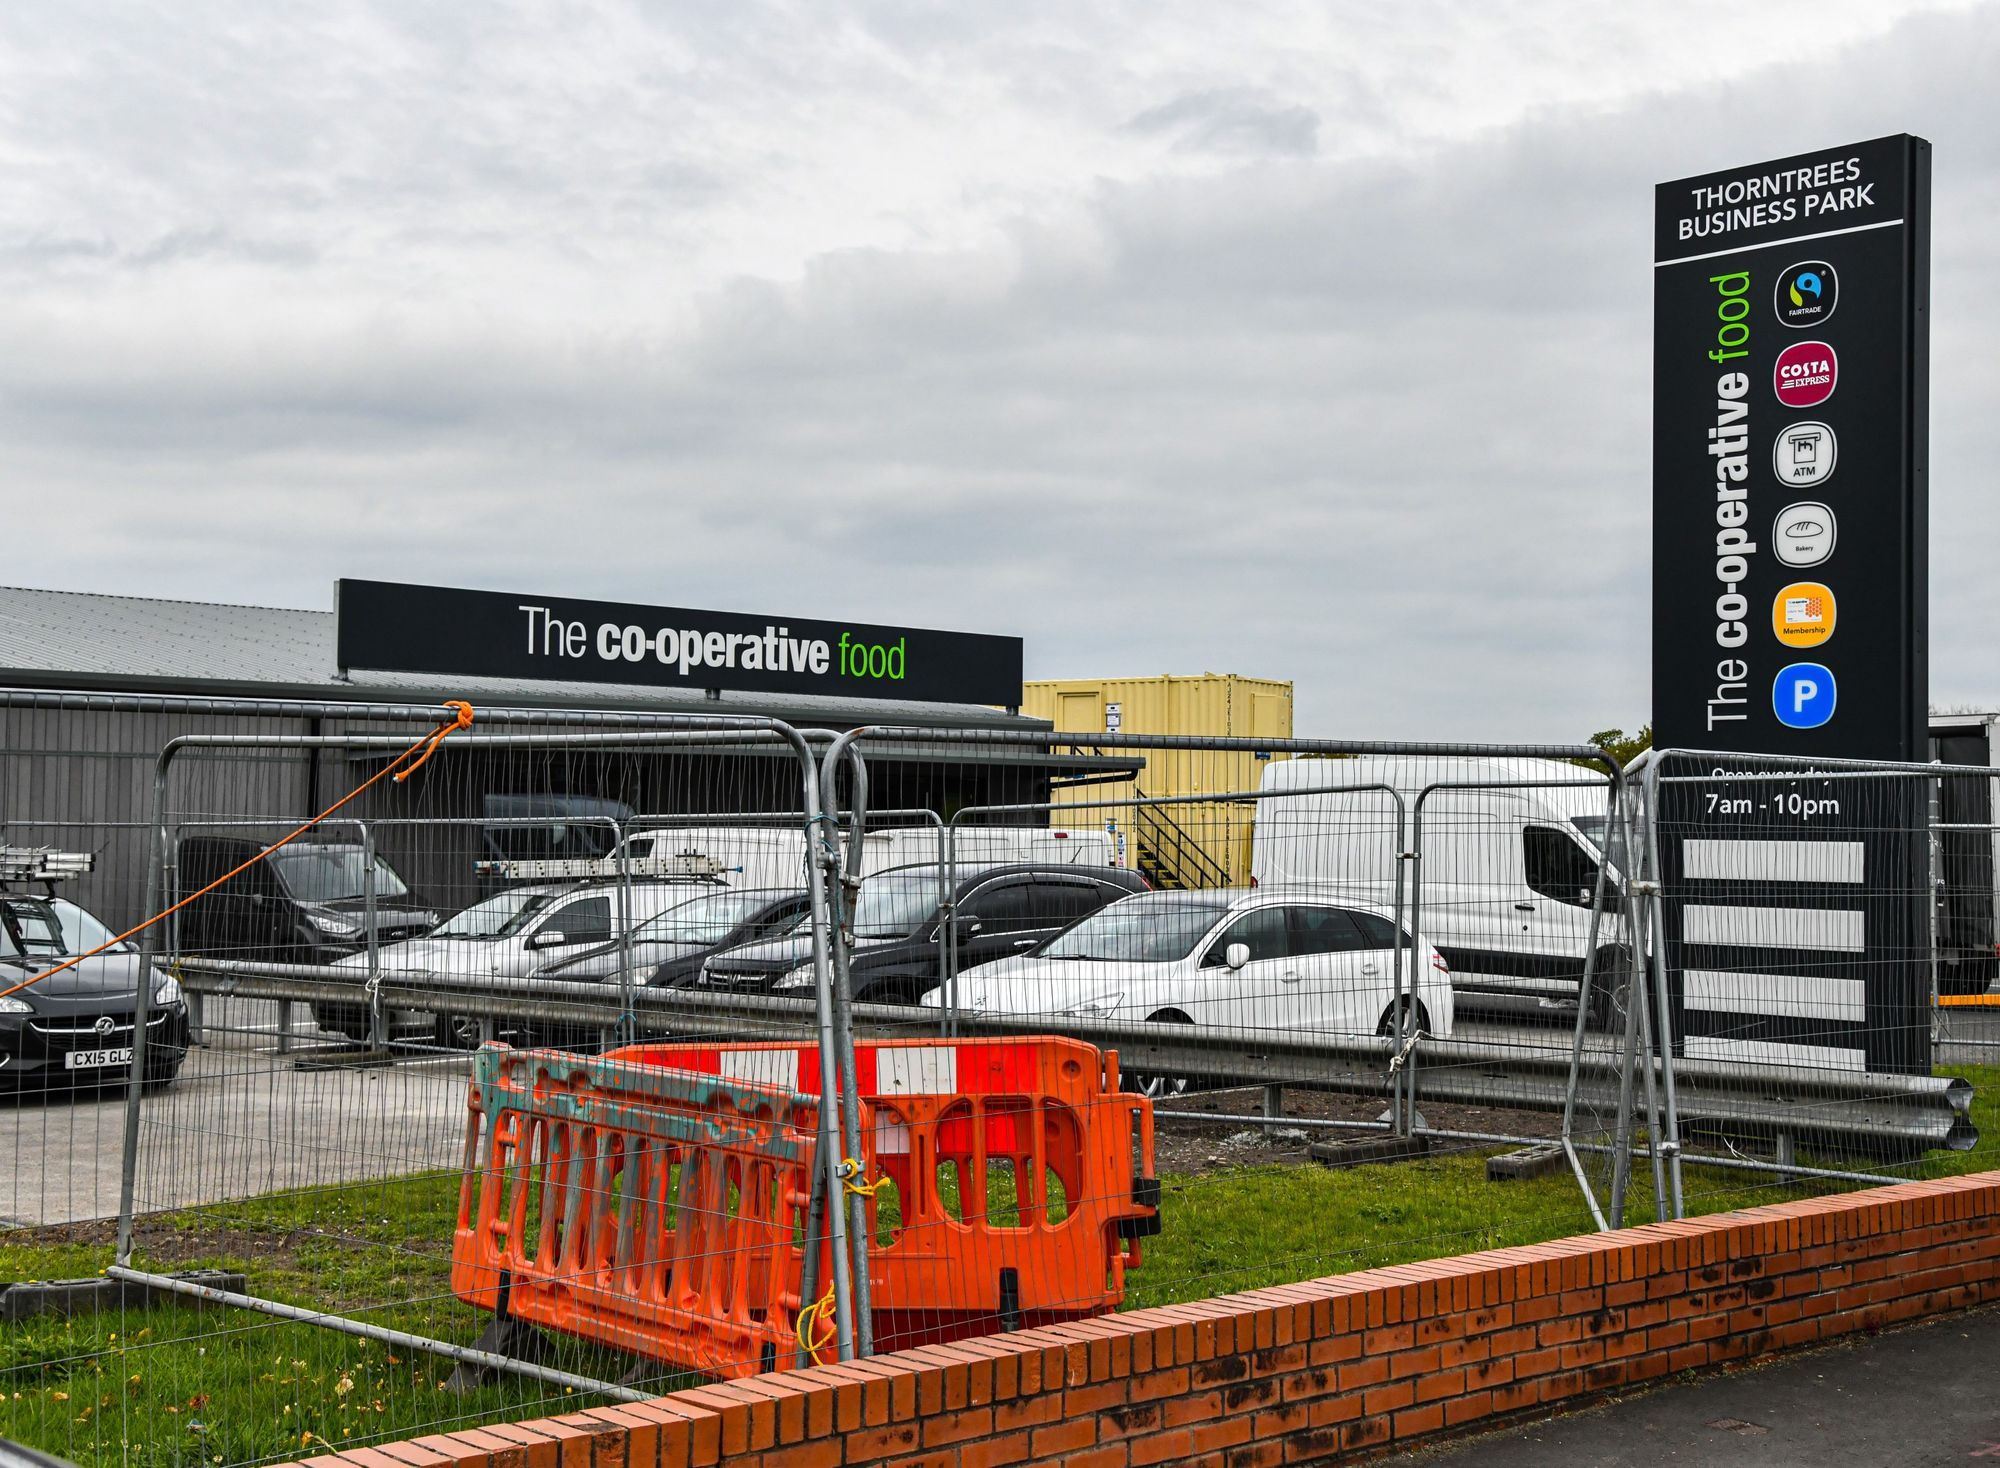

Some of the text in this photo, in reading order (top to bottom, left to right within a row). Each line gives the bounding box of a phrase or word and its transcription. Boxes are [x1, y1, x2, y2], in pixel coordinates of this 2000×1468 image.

[1691, 157, 1861, 210] THORNTREES
[1678, 183, 1875, 241] BUSINESS PARK
[1788, 304, 1822, 317] FAIRTRADE
[1780, 360, 1830, 378] COSTA
[1794, 375, 1830, 388] EXPRESS
[1792, 466, 1816, 477] ATM
[1707, 271, 1757, 732] The co-operative food
[1795, 545, 1814, 553] Bakery
[1783, 626, 1826, 636] Membership
[518, 605, 905, 680] The co-operative food
[1794, 679, 1819, 713] P
[1706, 793, 1752, 815] 7am
[1774, 793, 1840, 821] 10pm
[75, 1052, 105, 1065] CX15
